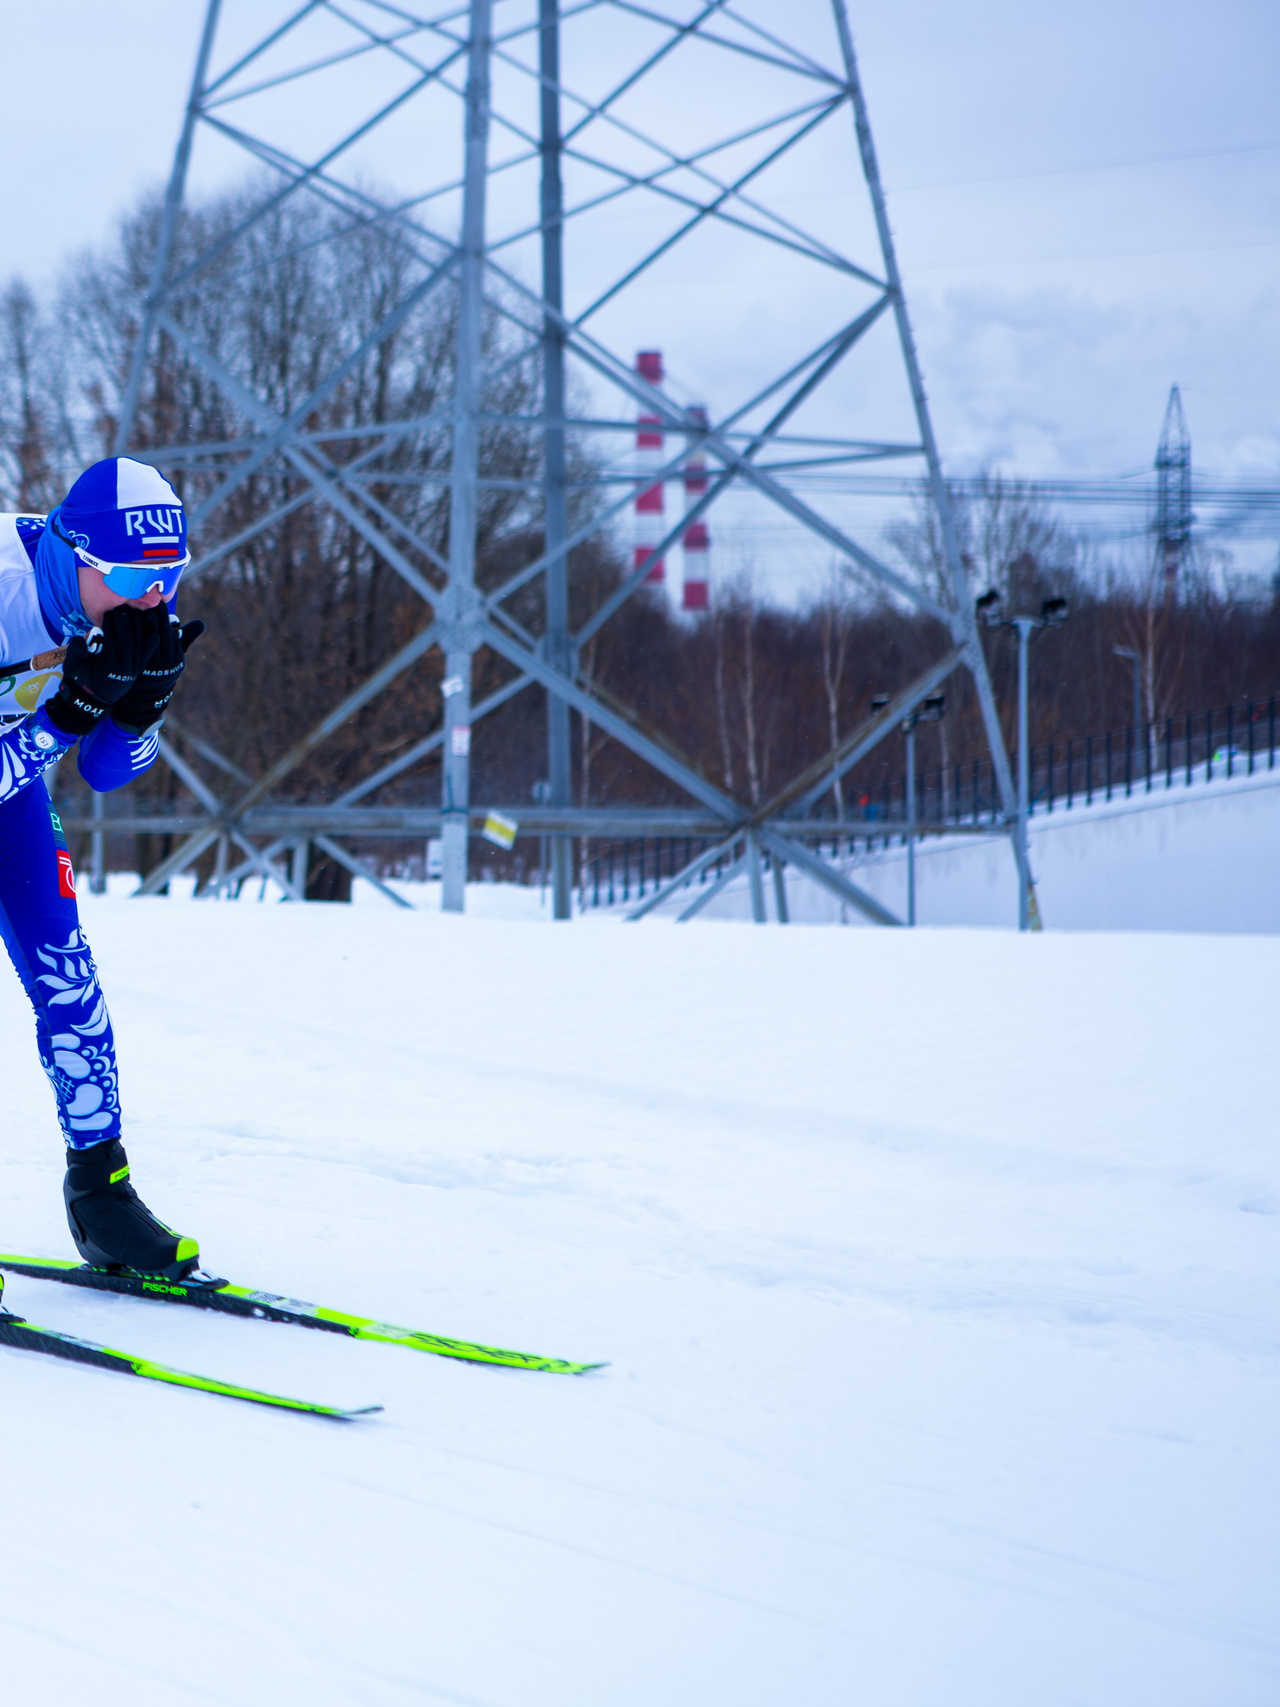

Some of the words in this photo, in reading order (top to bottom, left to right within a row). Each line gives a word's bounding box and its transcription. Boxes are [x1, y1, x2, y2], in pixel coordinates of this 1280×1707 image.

[125, 509, 183, 536] RWT
[142, 661, 184, 677] MADSHUS
[74, 698, 105, 716] MOAX
[142, 1281, 188, 1297] FISCHER
